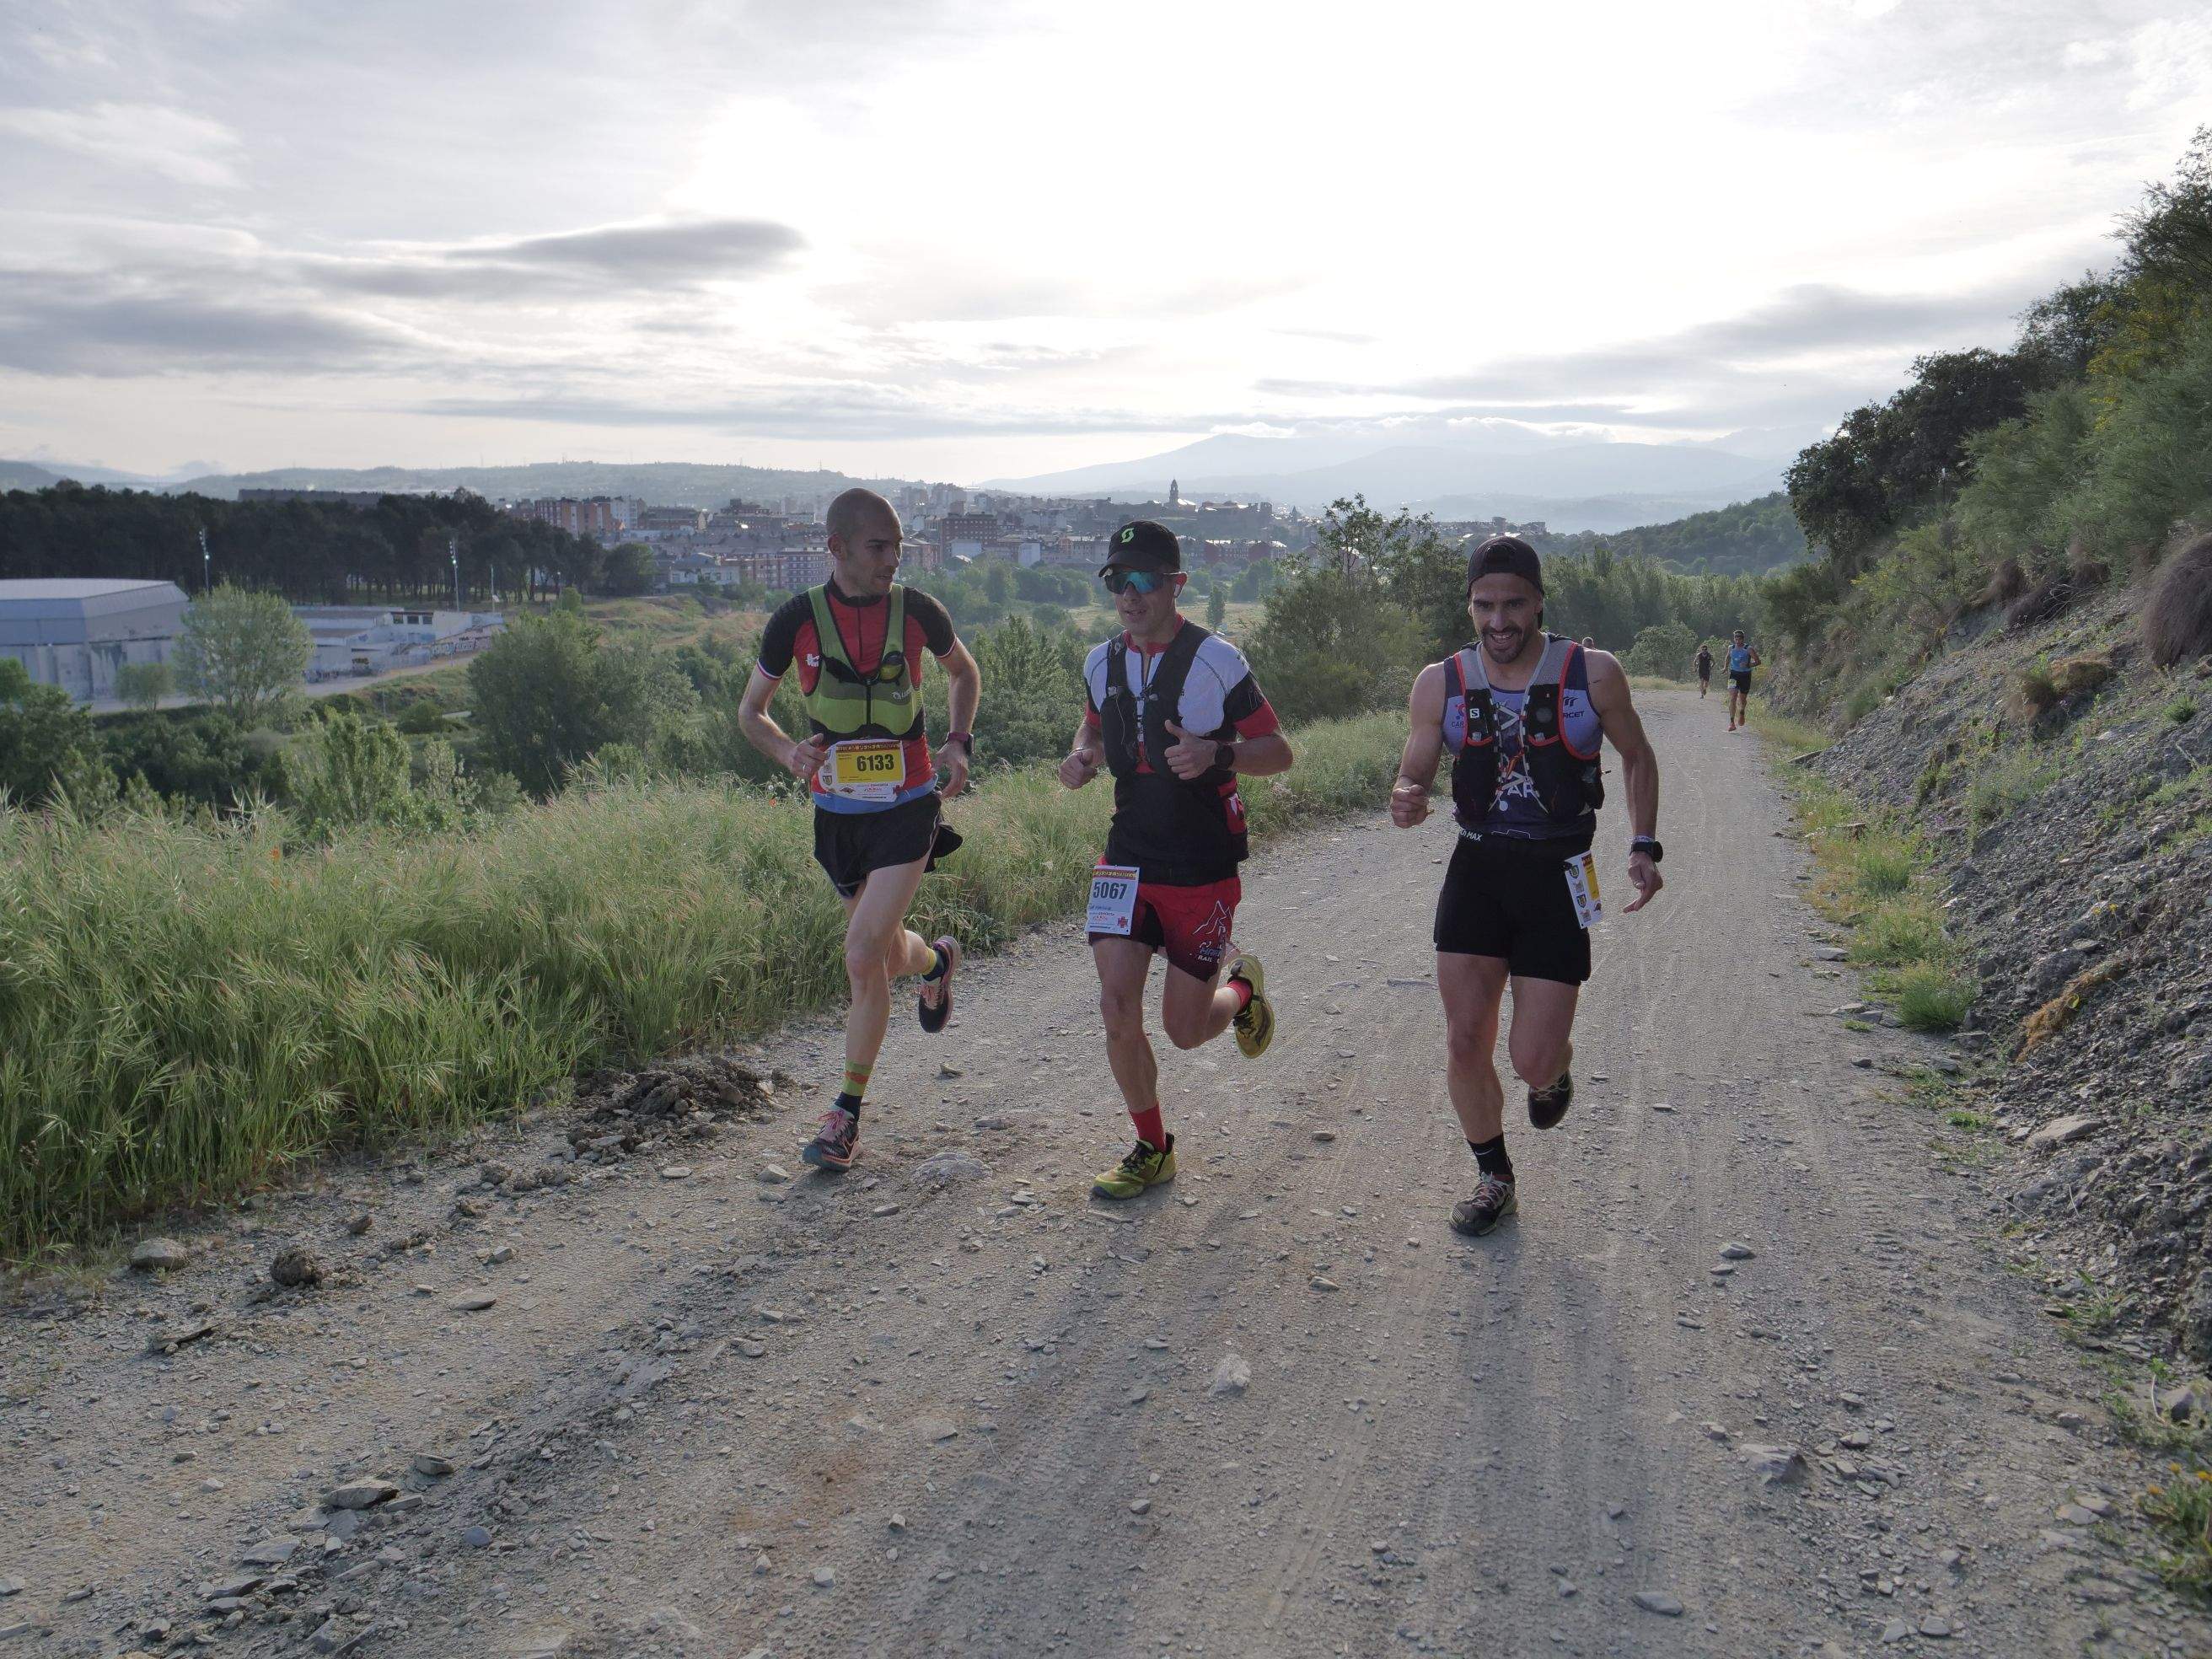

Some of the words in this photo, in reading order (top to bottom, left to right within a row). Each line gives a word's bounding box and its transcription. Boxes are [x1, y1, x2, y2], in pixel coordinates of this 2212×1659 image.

[856, 754, 894, 771] 6133
[1467, 831, 1483, 841] MAX
[1093, 881, 1128, 900] 5067
